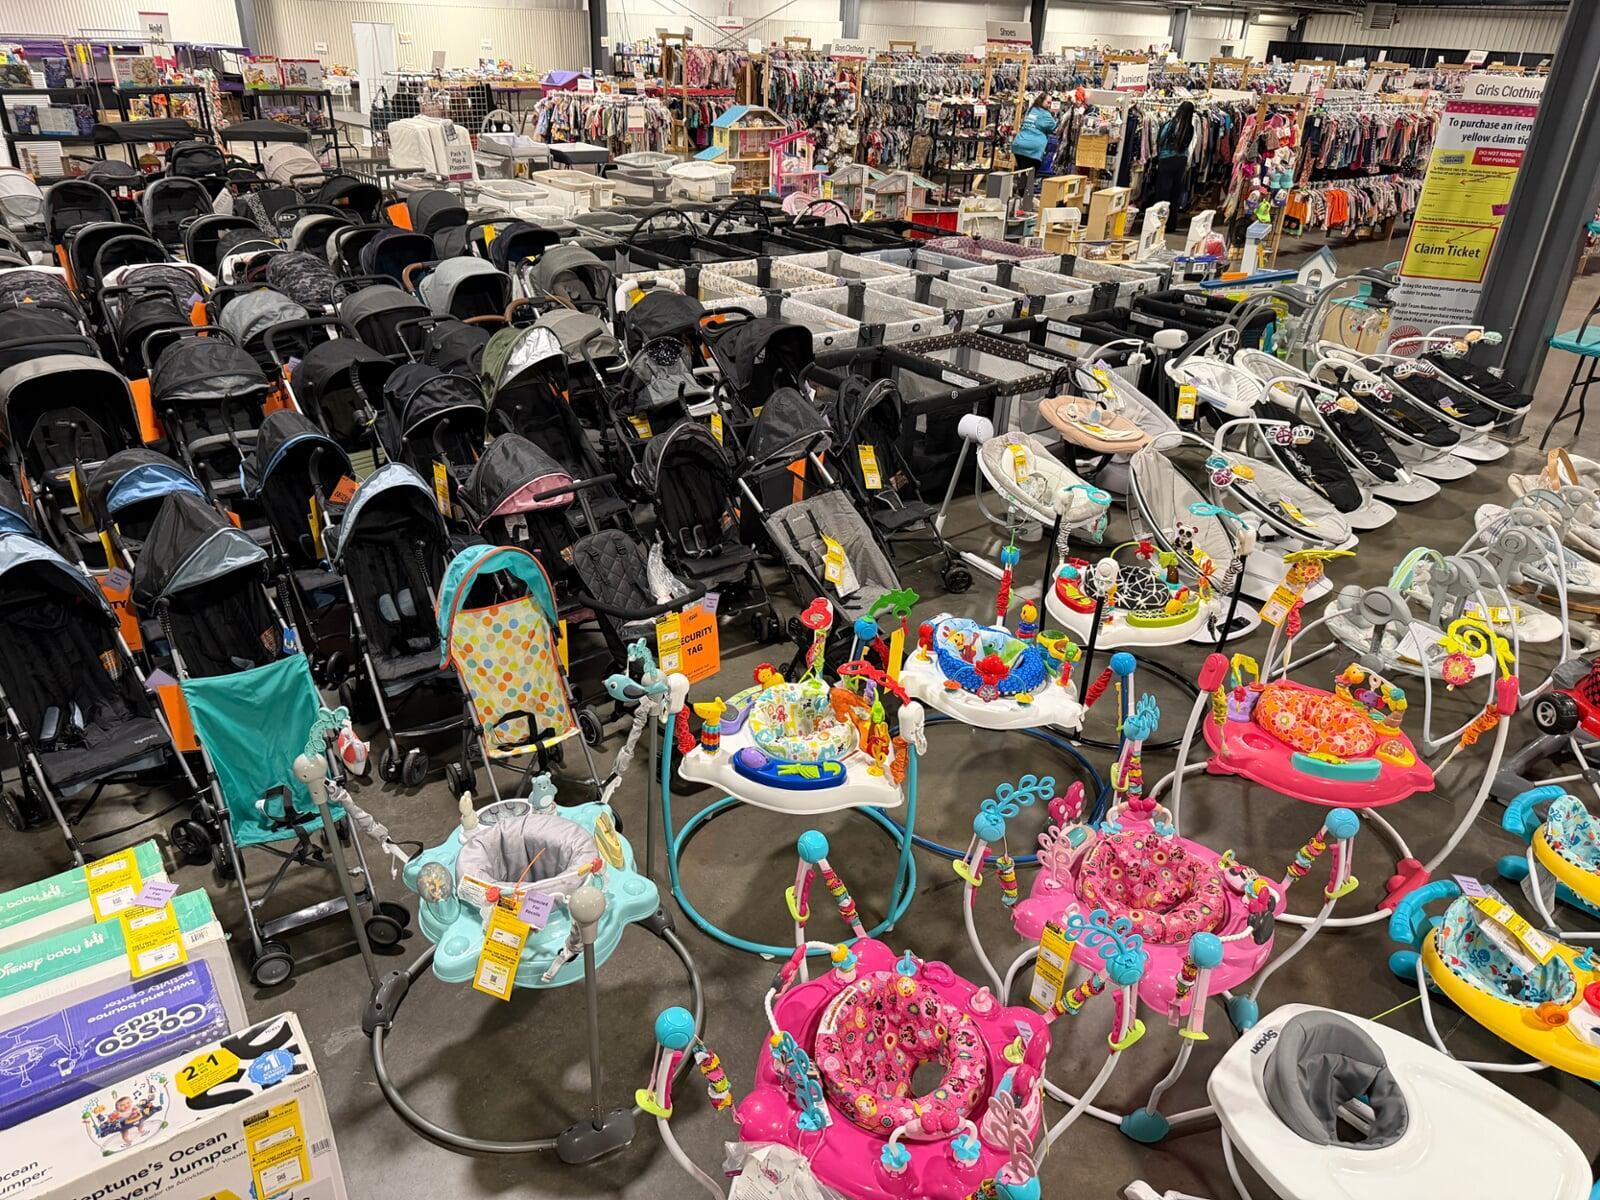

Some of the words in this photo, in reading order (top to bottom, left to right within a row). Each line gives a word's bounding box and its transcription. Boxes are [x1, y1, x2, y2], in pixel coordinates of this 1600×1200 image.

[1000, 28, 1016, 36] Shoes
[835, 44, 845, 52] Boys
[846, 44, 864, 54] Clothing
[1120, 75, 1144, 83] Juniors
[1475, 84, 1499, 96] Girls
[1449, 118, 1459, 127] To
[1460, 119, 1500, 130] purchase
[1461, 132, 1489, 143] yellow
[1492, 134, 1516, 144] claim
[1414, 243, 1445, 255] Claim
[1447, 244, 1480, 258] Ticket
[681, 625, 713, 646] ECURITY
[687, 643, 703, 656] TAG
[6, 891, 38, 909] baby
[47, 944, 82, 961] baby
[149, 971, 193, 993] activity
[87, 979, 197, 1024] twirl-and-bounce
[103, 989, 146, 1010] center
[114, 1007, 168, 1035] kids
[1250, 1029, 1278, 1055] Spoon
[182, 1066, 198, 1081] 2
[206, 1054, 219, 1066] 1
[74, 1163, 163, 1200] eptune's
[169, 1132, 228, 1163] Ocean
[170, 1140, 239, 1180] Jumper
[0, 1169, 47, 1195] umper
